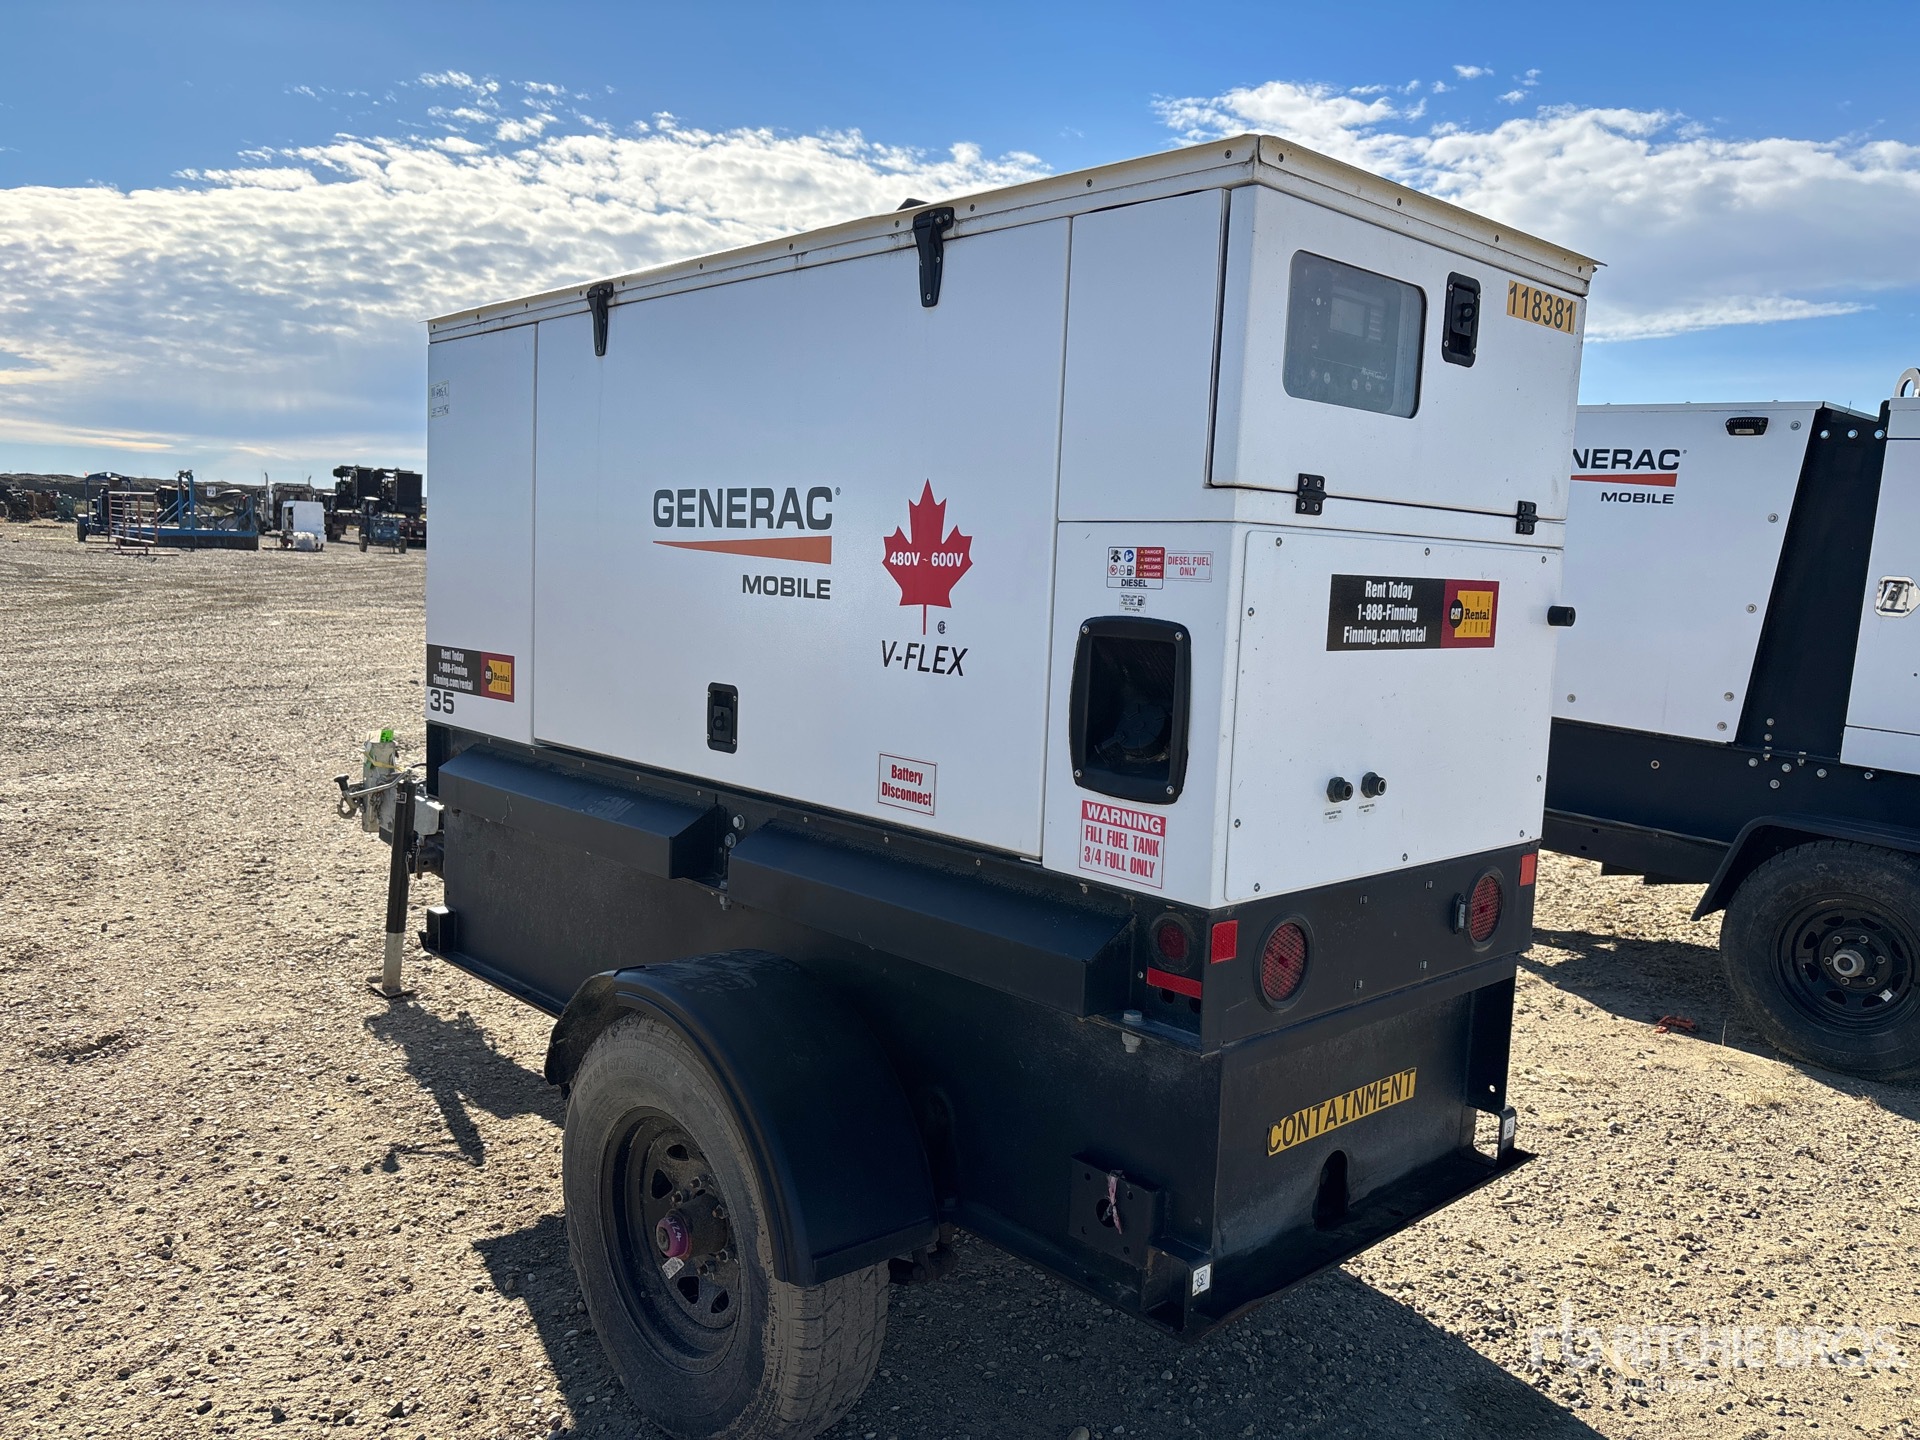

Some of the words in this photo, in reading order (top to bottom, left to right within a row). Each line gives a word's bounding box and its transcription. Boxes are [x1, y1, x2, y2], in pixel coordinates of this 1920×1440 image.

[1509, 282, 1574, 332] 118381
[1572, 448, 1681, 471] NERAC
[652, 486, 833, 531] GENERAC
[1600, 492, 1675, 505] MOBILE
[889, 551, 921, 567] 480V
[930, 552, 964, 568] 600V
[1167, 556, 1191, 566] DIESEL
[1192, 557, 1210, 566] FUEL
[1179, 566, 1197, 576] ONLY
[742, 574, 831, 600] MOBILE
[1120, 578, 1148, 588] DIESEL
[1365, 580, 1387, 599] Rent
[1388, 581, 1414, 601] Today
[1357, 604, 1419, 623] 1-888-Finning
[1450, 607, 1462, 620] CAT
[1464, 608, 1490, 620] Rental
[1343, 626, 1427, 645] Finning.com/rental
[440, 648, 452, 660] Rent
[451, 650, 465, 664] Today
[881, 639, 969, 677] V-FLEX
[433, 673, 474, 691] Finning.com/rental
[493, 672, 510, 683] Rental
[429, 689, 455, 715] 35
[891, 764, 923, 786] Battery
[882, 781, 932, 807] Disconnect
[1086, 803, 1162, 834] WARNING
[1085, 824, 1103, 845] FILL
[1106, 829, 1129, 850] FUEL
[1132, 835, 1160, 858] TANK
[1084, 845, 1102, 866] 3/4
[1104, 850, 1127, 872] FULL
[1129, 856, 1156, 879] ONLY
[1267, 1068, 1416, 1153] CONTAINMENT
